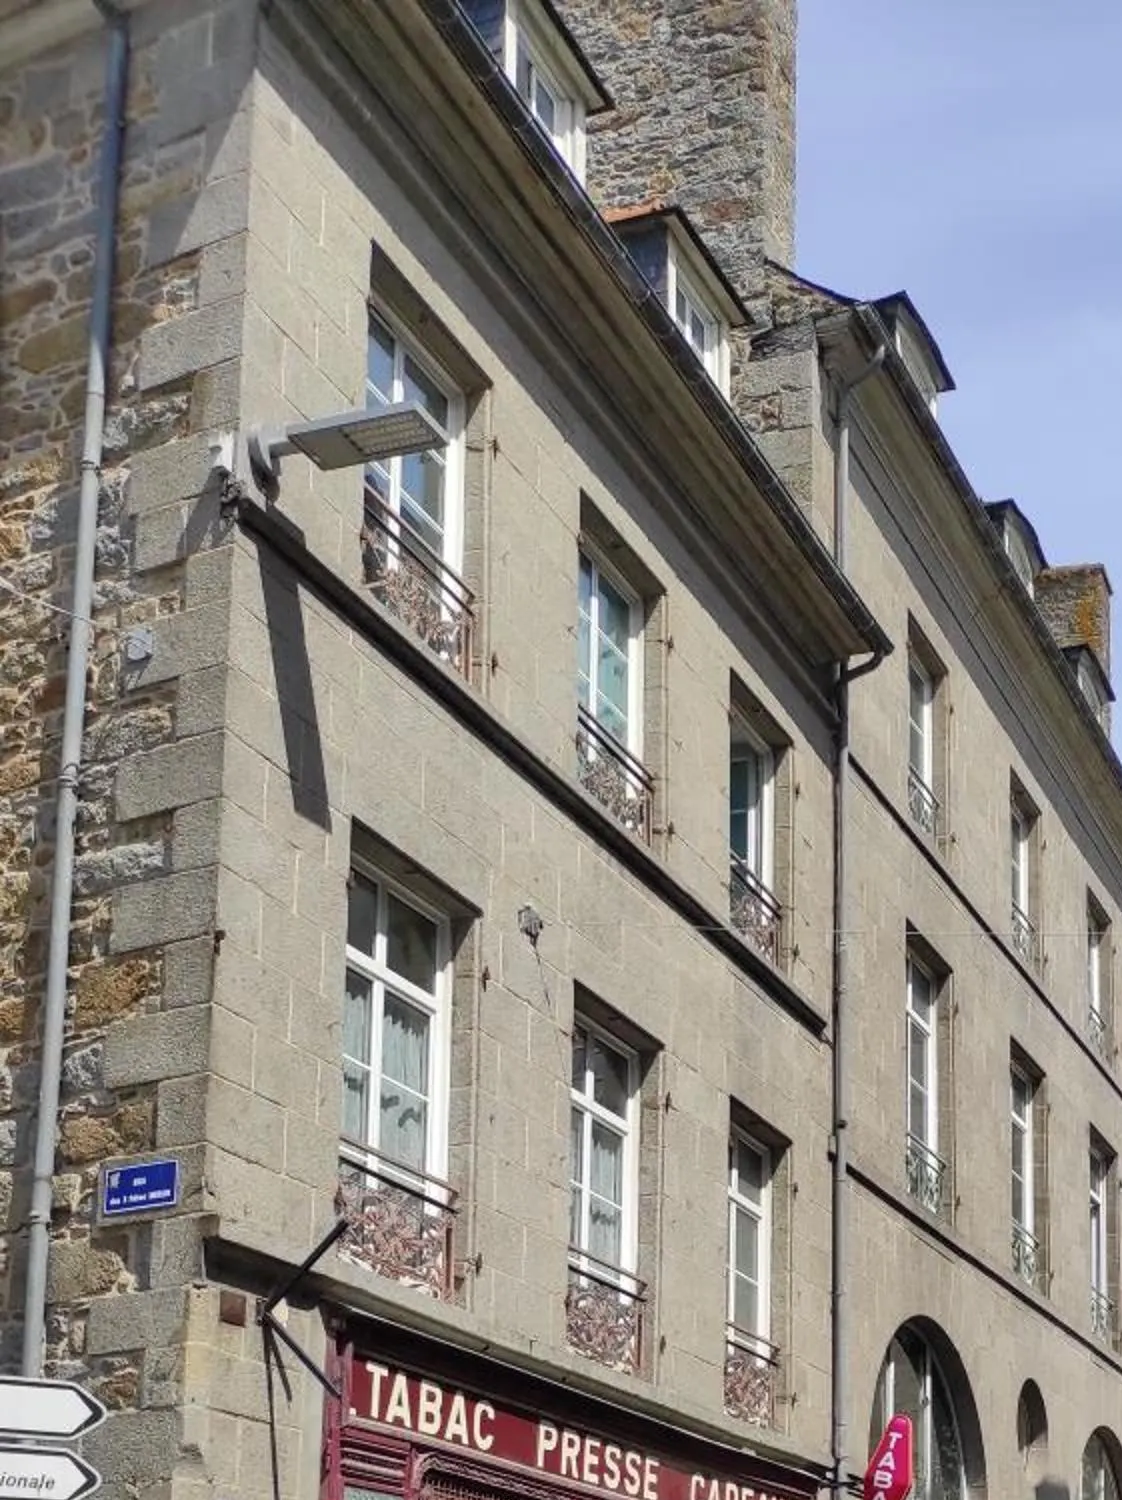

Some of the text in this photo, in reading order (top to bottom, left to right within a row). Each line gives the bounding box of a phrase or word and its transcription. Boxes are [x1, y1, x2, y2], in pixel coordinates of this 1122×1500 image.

[365, 1362, 495, 1451] TABAC
[537, 1424, 660, 1500] PRESSE
[0, 1471, 56, 1490] ionale
